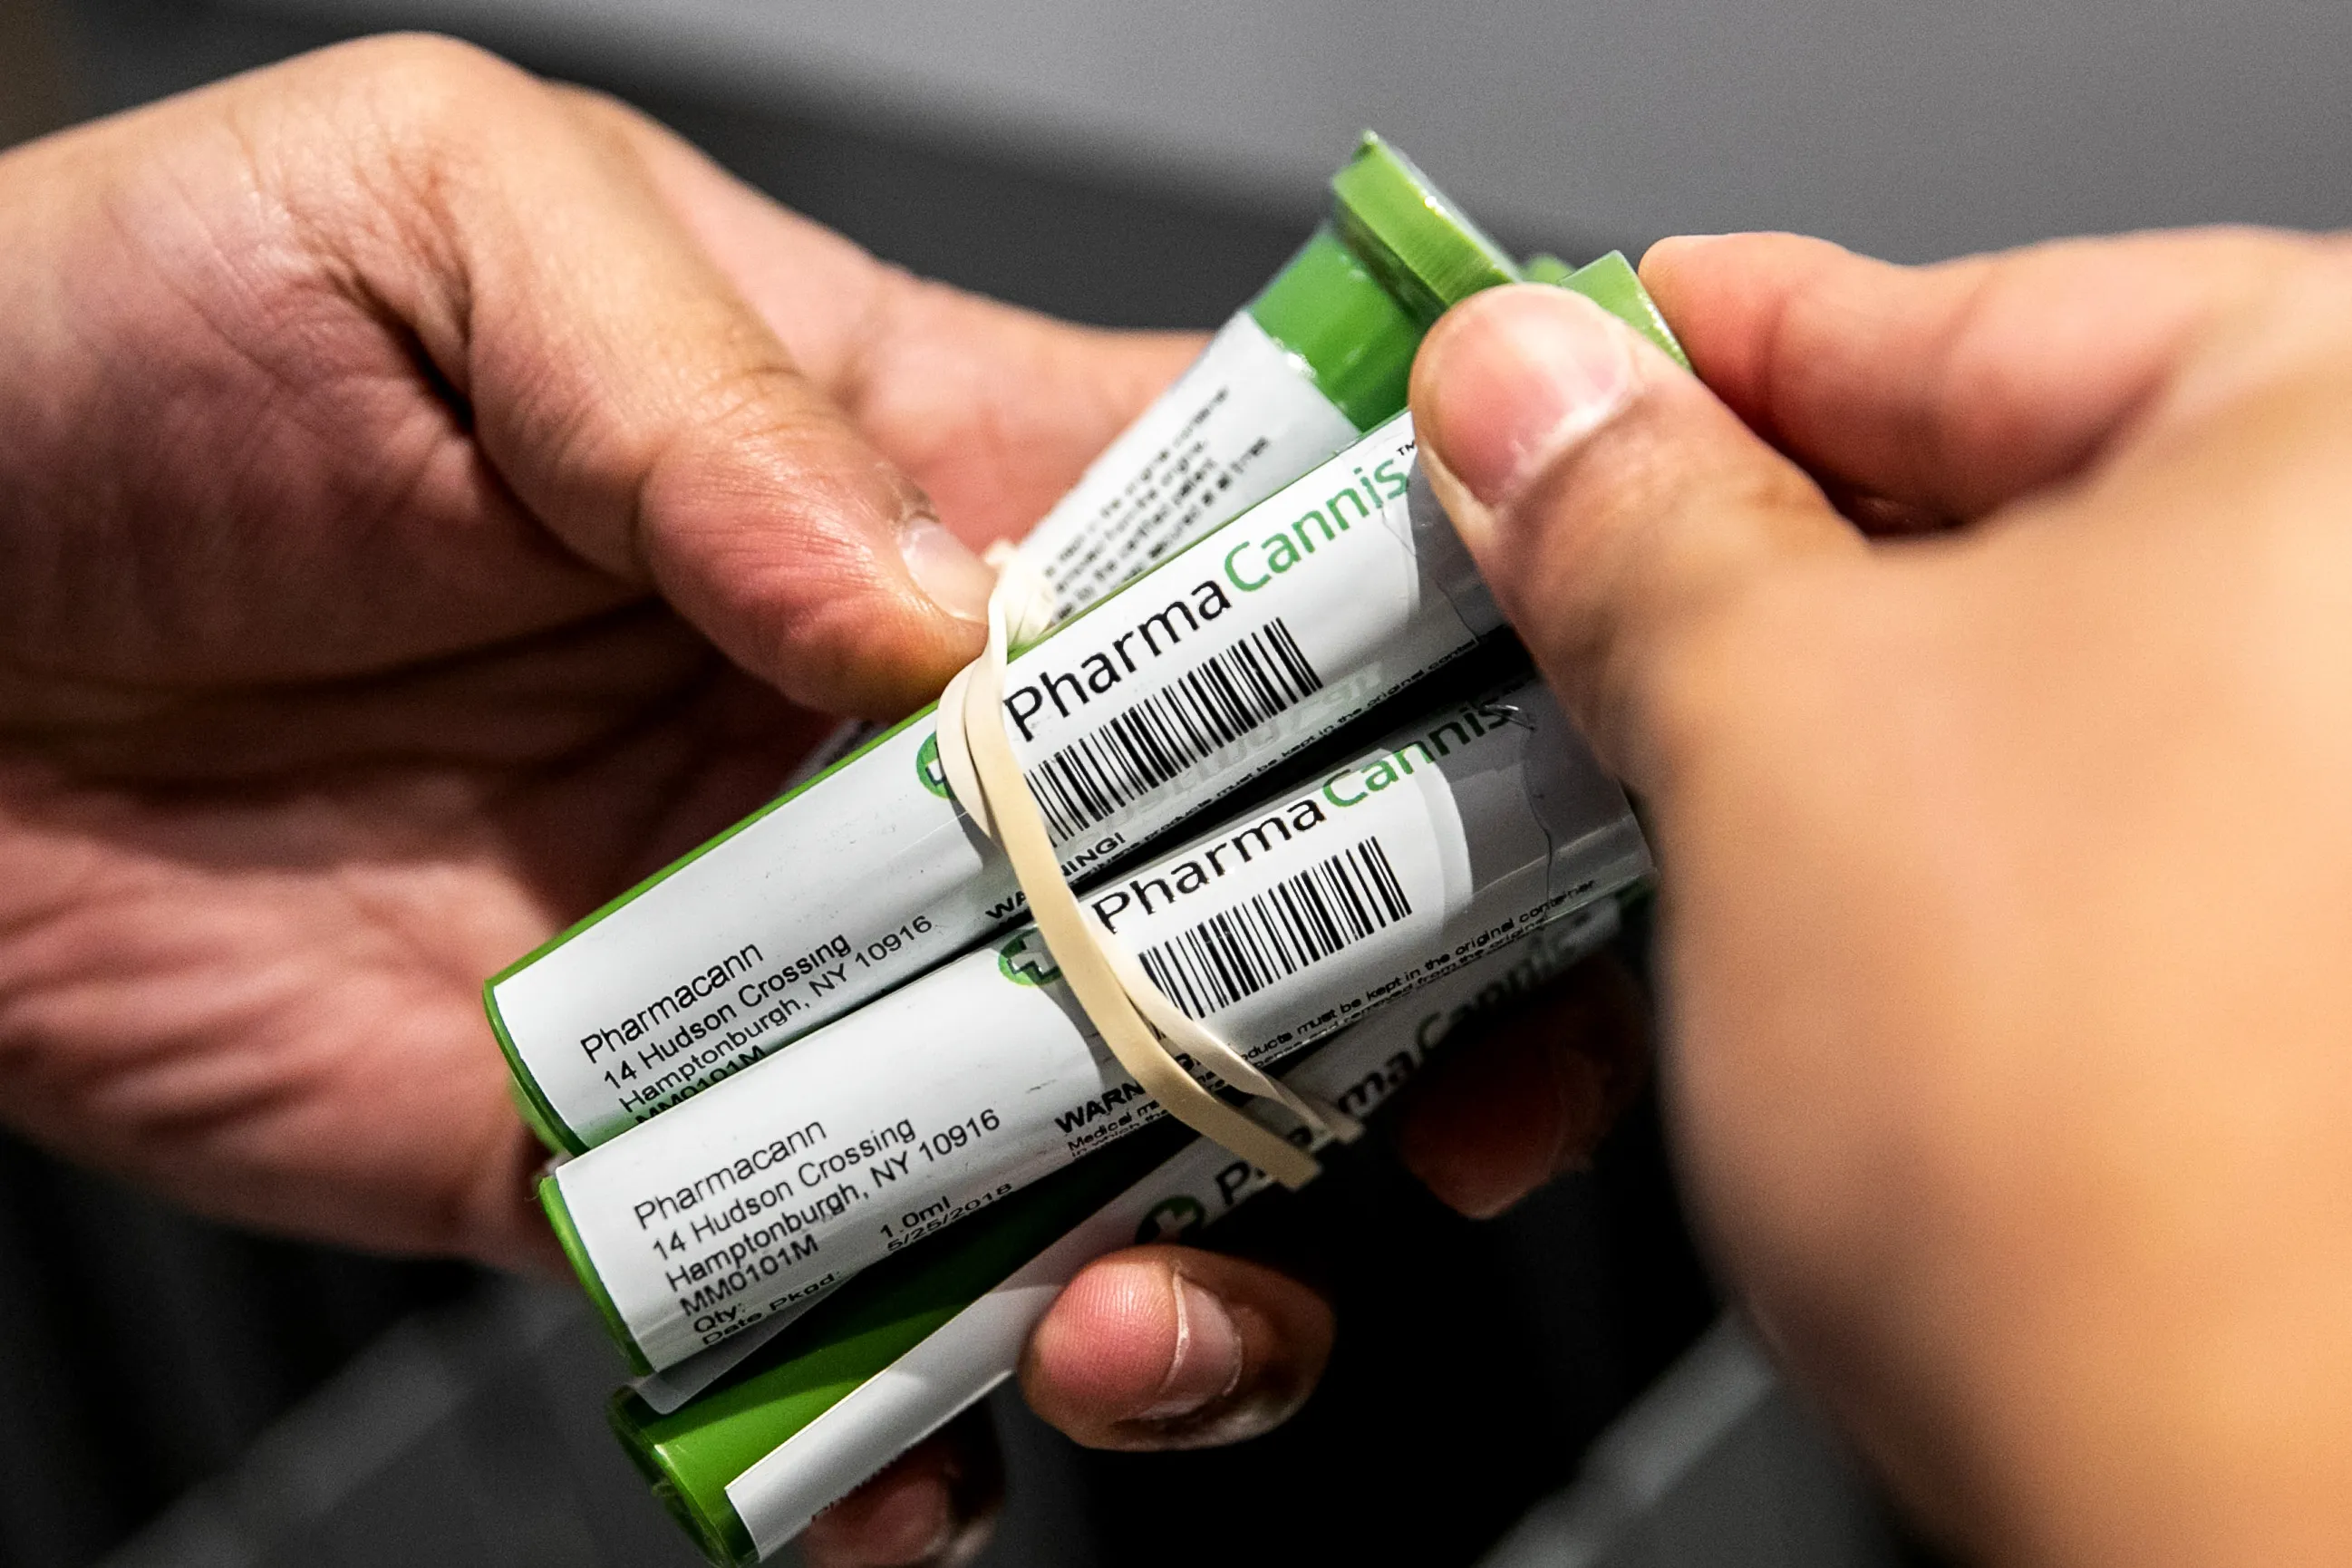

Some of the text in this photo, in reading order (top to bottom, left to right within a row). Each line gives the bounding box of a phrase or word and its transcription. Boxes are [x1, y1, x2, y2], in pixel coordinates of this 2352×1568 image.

[986, 832, 1127, 920] WAING!
[580, 944, 764, 1064] Pharmacann
[605, 934, 851, 1089] 14 Hudson Crossing
[619, 915, 932, 1113] Hamptonburgh, NY 10916
[1068, 1113, 1134, 1151] Medical
[1296, 1009, 1339, 1035] must
[1340, 997, 1363, 1015] be
[1366, 975, 1402, 1002] kept
[1404, 968, 1421, 982] in
[1425, 953, 1450, 971] the
[1456, 919, 1515, 955] original
[634, 1121, 827, 1230] Pharmacann
[653, 1118, 915, 1260] 14 Hudson Crossing
[665, 1108, 1000, 1292] Hamptonburgh, NY 10916
[680, 1234, 819, 1316] MM0101M
[693, 1195, 951, 1334] Qty: 1.0ml
[702, 1312, 762, 1345] Date
[886, 1183, 1012, 1252] 5/25/2018
